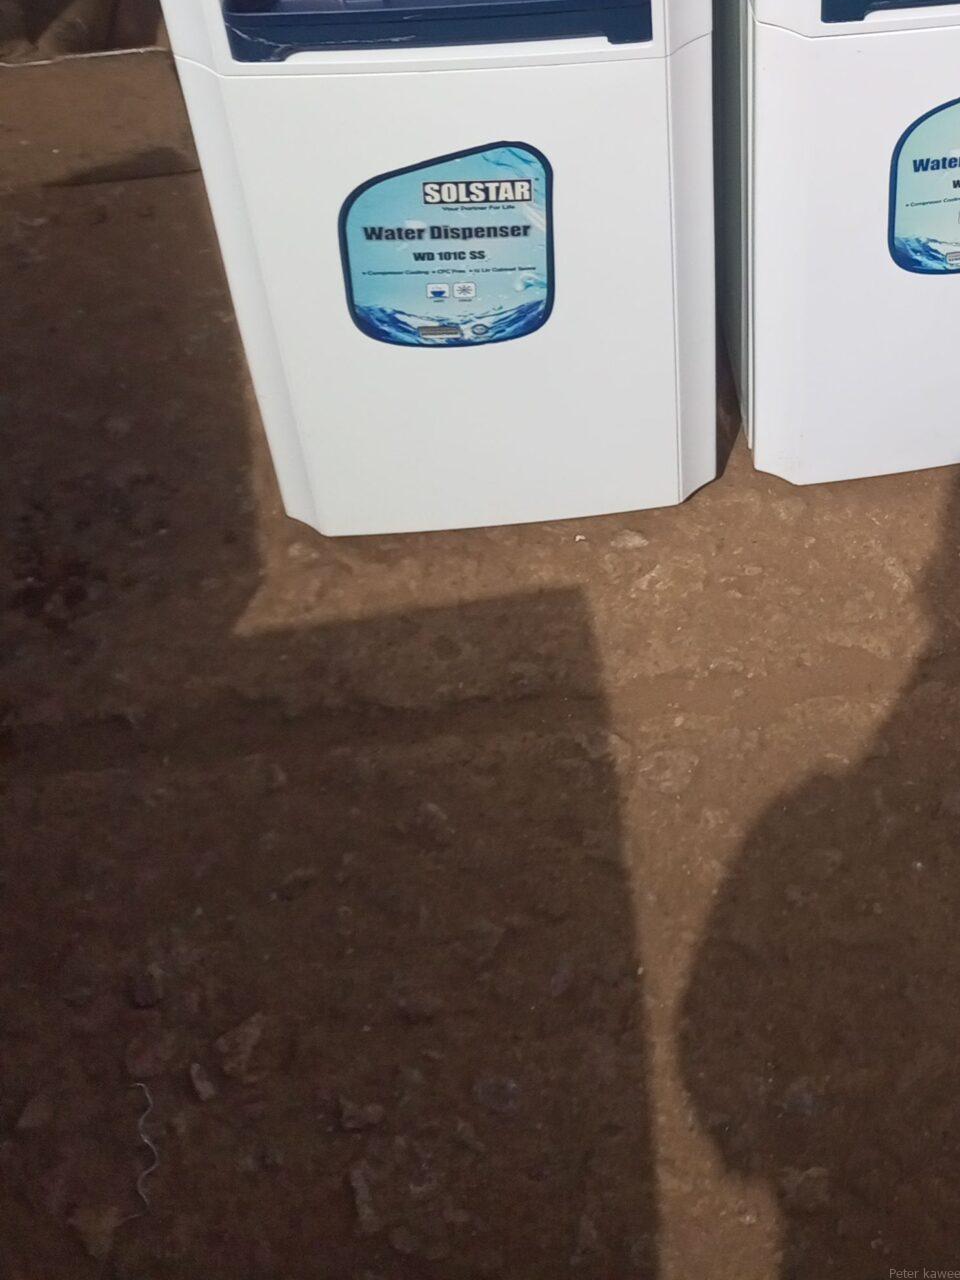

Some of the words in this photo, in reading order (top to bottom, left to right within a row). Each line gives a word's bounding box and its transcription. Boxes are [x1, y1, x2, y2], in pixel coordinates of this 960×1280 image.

[423, 181, 531, 204] SOLSTAR
[363, 226, 425, 241] Water
[429, 224, 531, 240] Dispenser
[413, 252, 435, 262] WD
[437, 251, 466, 261] 101C
[469, 250, 486, 260] SS
